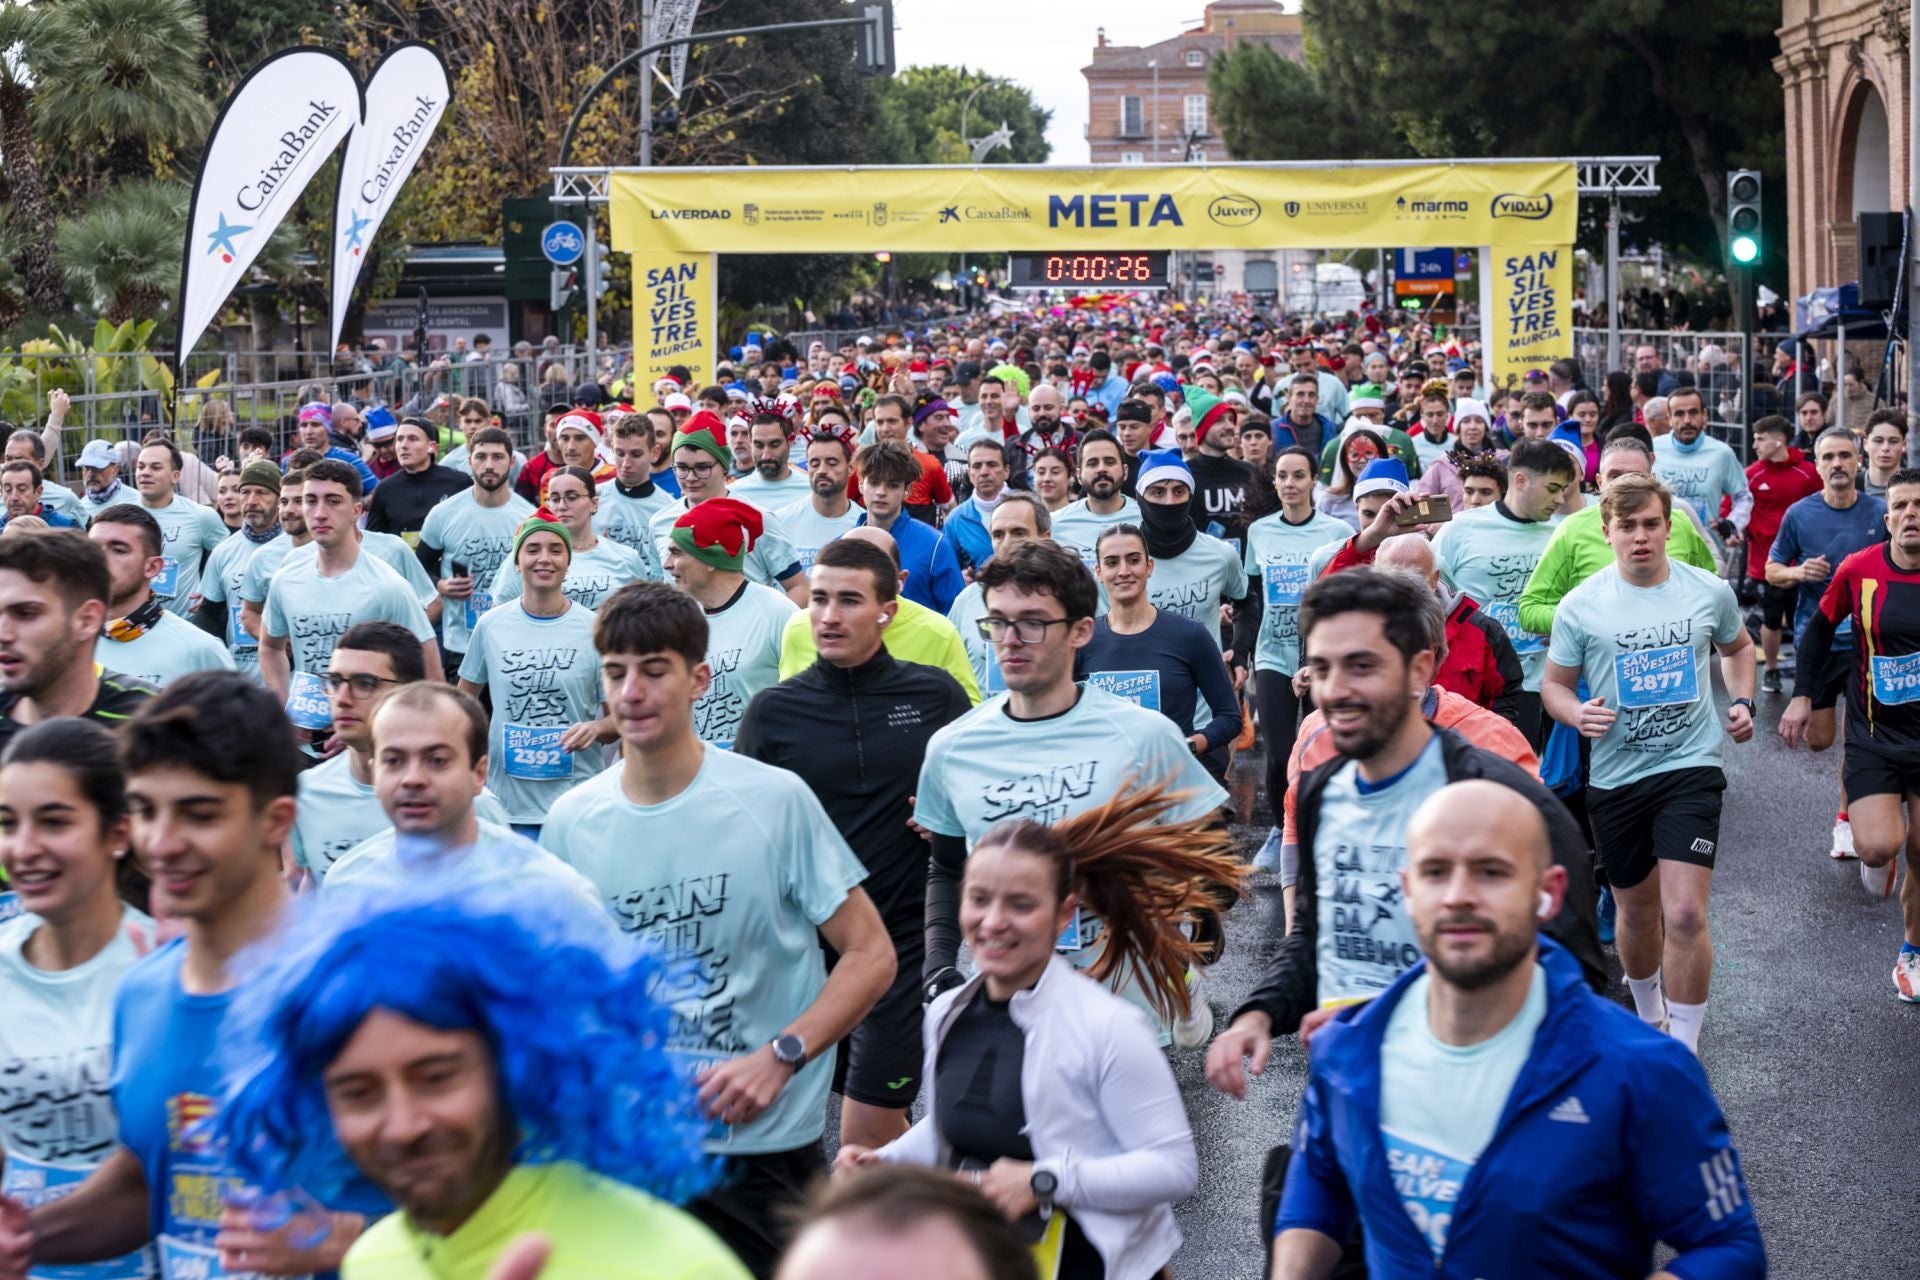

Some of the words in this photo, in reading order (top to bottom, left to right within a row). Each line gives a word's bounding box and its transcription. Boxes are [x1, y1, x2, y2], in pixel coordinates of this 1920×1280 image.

[237, 100, 336, 211] CaixaBank
[361, 95, 438, 204] CaixaBank
[651, 210, 669, 219] LA
[673, 209, 731, 219] VERDAD
[965, 206, 1031, 219] CaixaBank
[1048, 194, 1184, 228] META
[1213, 205, 1256, 218] Juver
[1412, 202, 1468, 212] marmo
[1500, 202, 1544, 212] VIDAL
[646, 262, 698, 288] SAN
[1047, 257, 1150, 281] 0:00:26
[1419, 263, 1442, 273] 24h
[1505, 250, 1557, 277] SAN
[654, 283, 690, 307] SIL
[1513, 272, 1550, 296] SIL
[650, 300, 696, 325] VES
[1508, 289, 1555, 315] VES
[437, 318, 472, 326] DENTAL
[651, 321, 697, 345] TRE
[1509, 310, 1556, 335] TRE
[650, 338, 702, 358] MURCIA
[1508, 328, 1560, 348] MURCIA
[649, 365, 661, 373] LA
[1521, 355, 1559, 363] VERDAD
[1662, 468, 1708, 485] SAN
[1614, 618, 1693, 651] SAN
[501, 648, 578, 674] SAN
[1623, 653, 1649, 670] SAN
[1623, 648, 1688, 680] SILVESTRE
[1661, 658, 1688, 673] MURCIA
[1879, 660, 1897, 671] SAN
[510, 671, 561, 698] SIL
[1094, 675, 1115, 686] SAN
[1127, 685, 1152, 695] MURCIA
[1630, 670, 1683, 692] 2877
[505, 693, 568, 722] VES
[509, 730, 531, 740] SAN
[513, 748, 561, 766] 2392
[981, 760, 1100, 823] SAN
[611, 872, 731, 933] SAN
[1387, 1148, 1446, 1180] SAN
